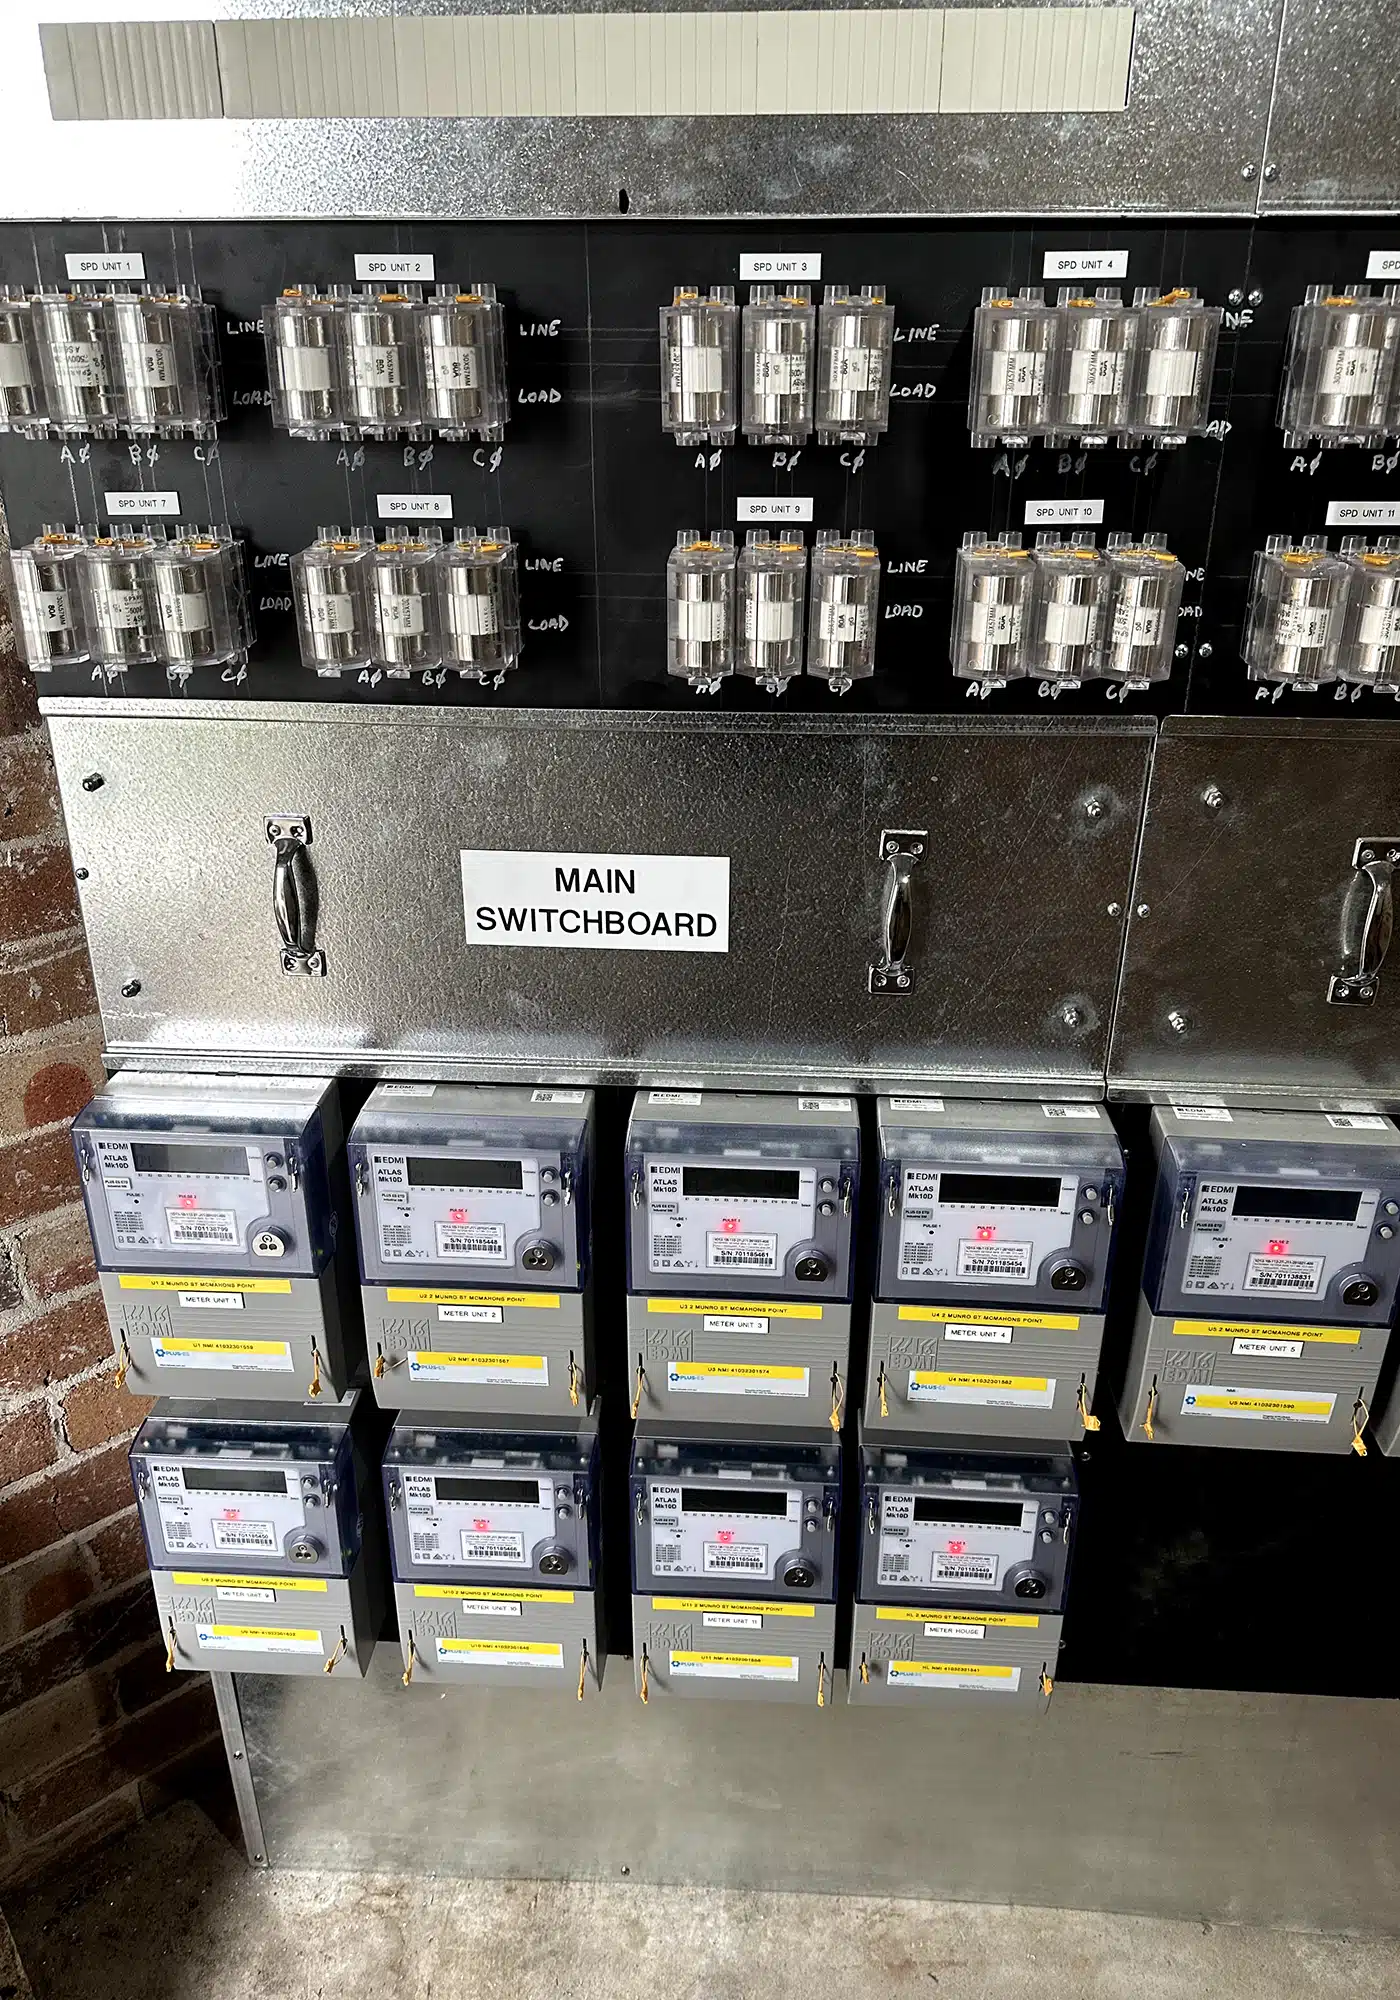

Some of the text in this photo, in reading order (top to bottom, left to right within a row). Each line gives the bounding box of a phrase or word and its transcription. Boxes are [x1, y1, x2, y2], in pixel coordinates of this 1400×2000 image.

[81, 262, 130, 271] SPD UNIT 1
[369, 263, 421, 272] SPD UNIT 2
[754, 262, 808, 272] SPD UNIT 3
[1058, 261, 1077, 270] SPD
[1082, 260, 1103, 270] UNIT
[227, 320, 264, 334] LINE
[520, 320, 562, 337] LINE
[894, 324, 940, 342] LINE
[518, 390, 562, 404] LOAD
[889, 383, 937, 398] LOAD
[233, 390, 272, 406] LOAD
[119, 500, 136, 508] SPD
[139, 500, 157, 508] UNIT
[390, 503, 407, 511] SPD
[434, 503, 440, 511] 8
[750, 506, 800, 514] SPD UNIT 9
[1036, 508, 1092, 517] SPD UNIT 10
[1340, 510, 1358, 518] SPD
[1363, 510, 1384, 518] UNIT
[254, 553, 290, 568] LINE
[525, 558, 564, 572] LINE
[887, 560, 928, 574] LINE
[260, 596, 292, 611] LOAD
[884, 604, 923, 618] LOAD
[528, 617, 568, 632] LOAD
[556, 868, 635, 894] MAIN
[477, 907, 717, 937] SWITCHBOARD
